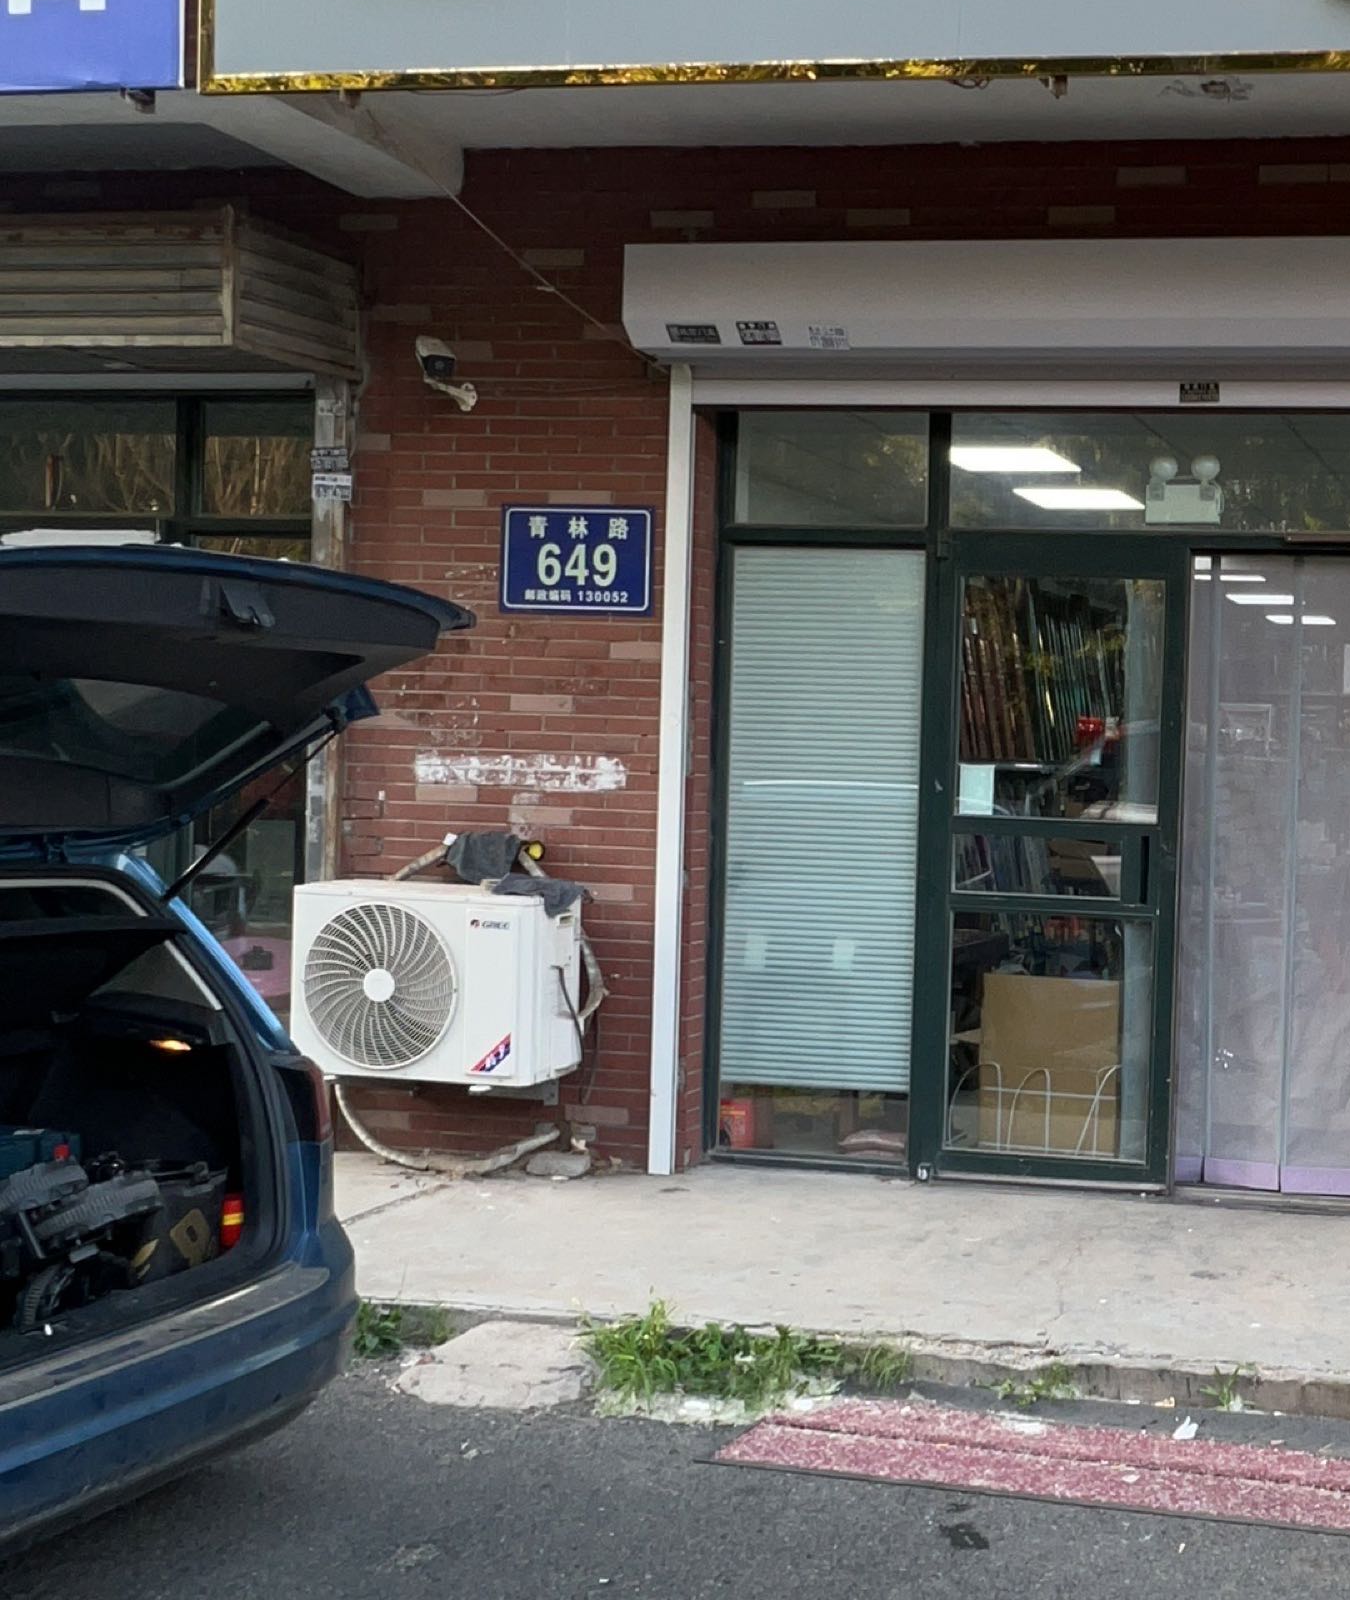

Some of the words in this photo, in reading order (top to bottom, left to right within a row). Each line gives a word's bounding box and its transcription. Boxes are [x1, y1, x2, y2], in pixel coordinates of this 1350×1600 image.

[528, 515, 629, 540] 青林路
[537, 542, 617, 587] 649
[577, 590, 628, 603] 130052
